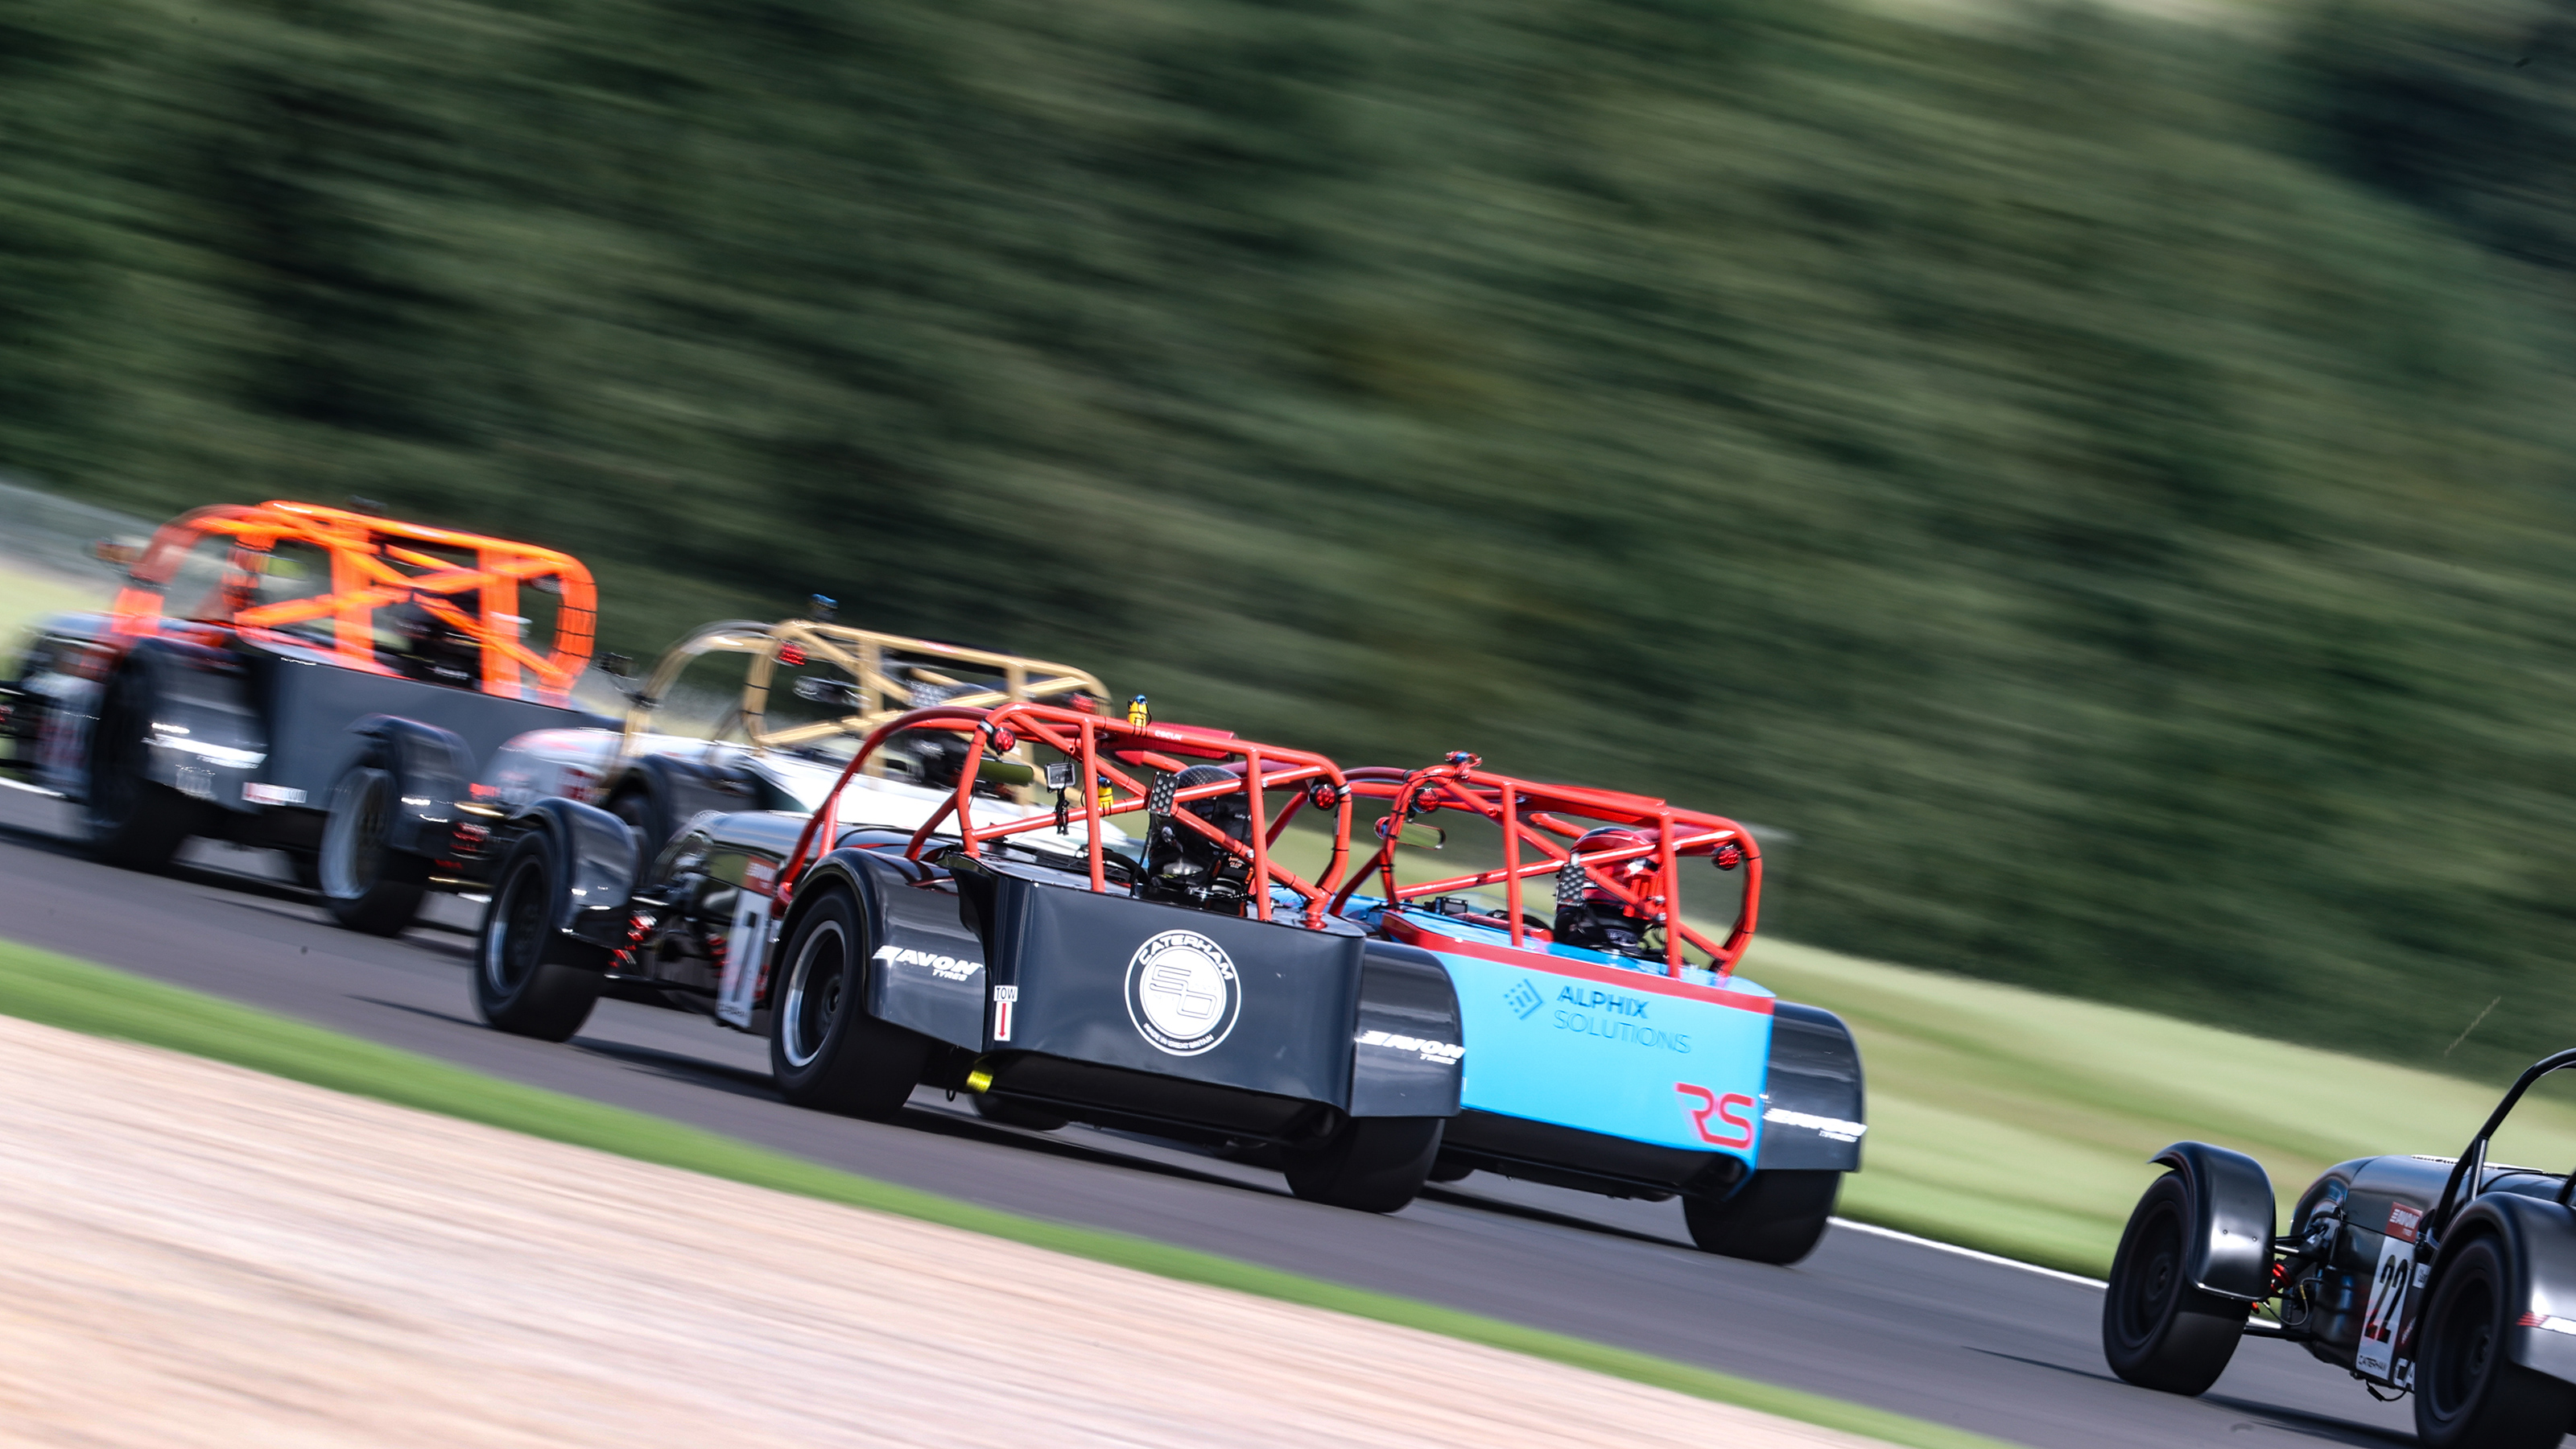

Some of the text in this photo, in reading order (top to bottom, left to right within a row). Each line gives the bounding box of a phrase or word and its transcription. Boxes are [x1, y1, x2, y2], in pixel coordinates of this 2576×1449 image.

[894, 949, 983, 976] AVON
[1138, 935, 1234, 980] CATERHAM
[932, 968, 968, 981] TYRES
[996, 987, 1016, 1000] TOW
[1557, 985, 1649, 1018] ALPHIX
[1189, 1034, 1214, 1049] BRITAIN
[1381, 1034, 1467, 1059] AVON
[1553, 1009, 1692, 1054] SOLUTIONS
[1674, 1082, 1757, 1150] RS
[2363, 1254, 2408, 1344] 22
